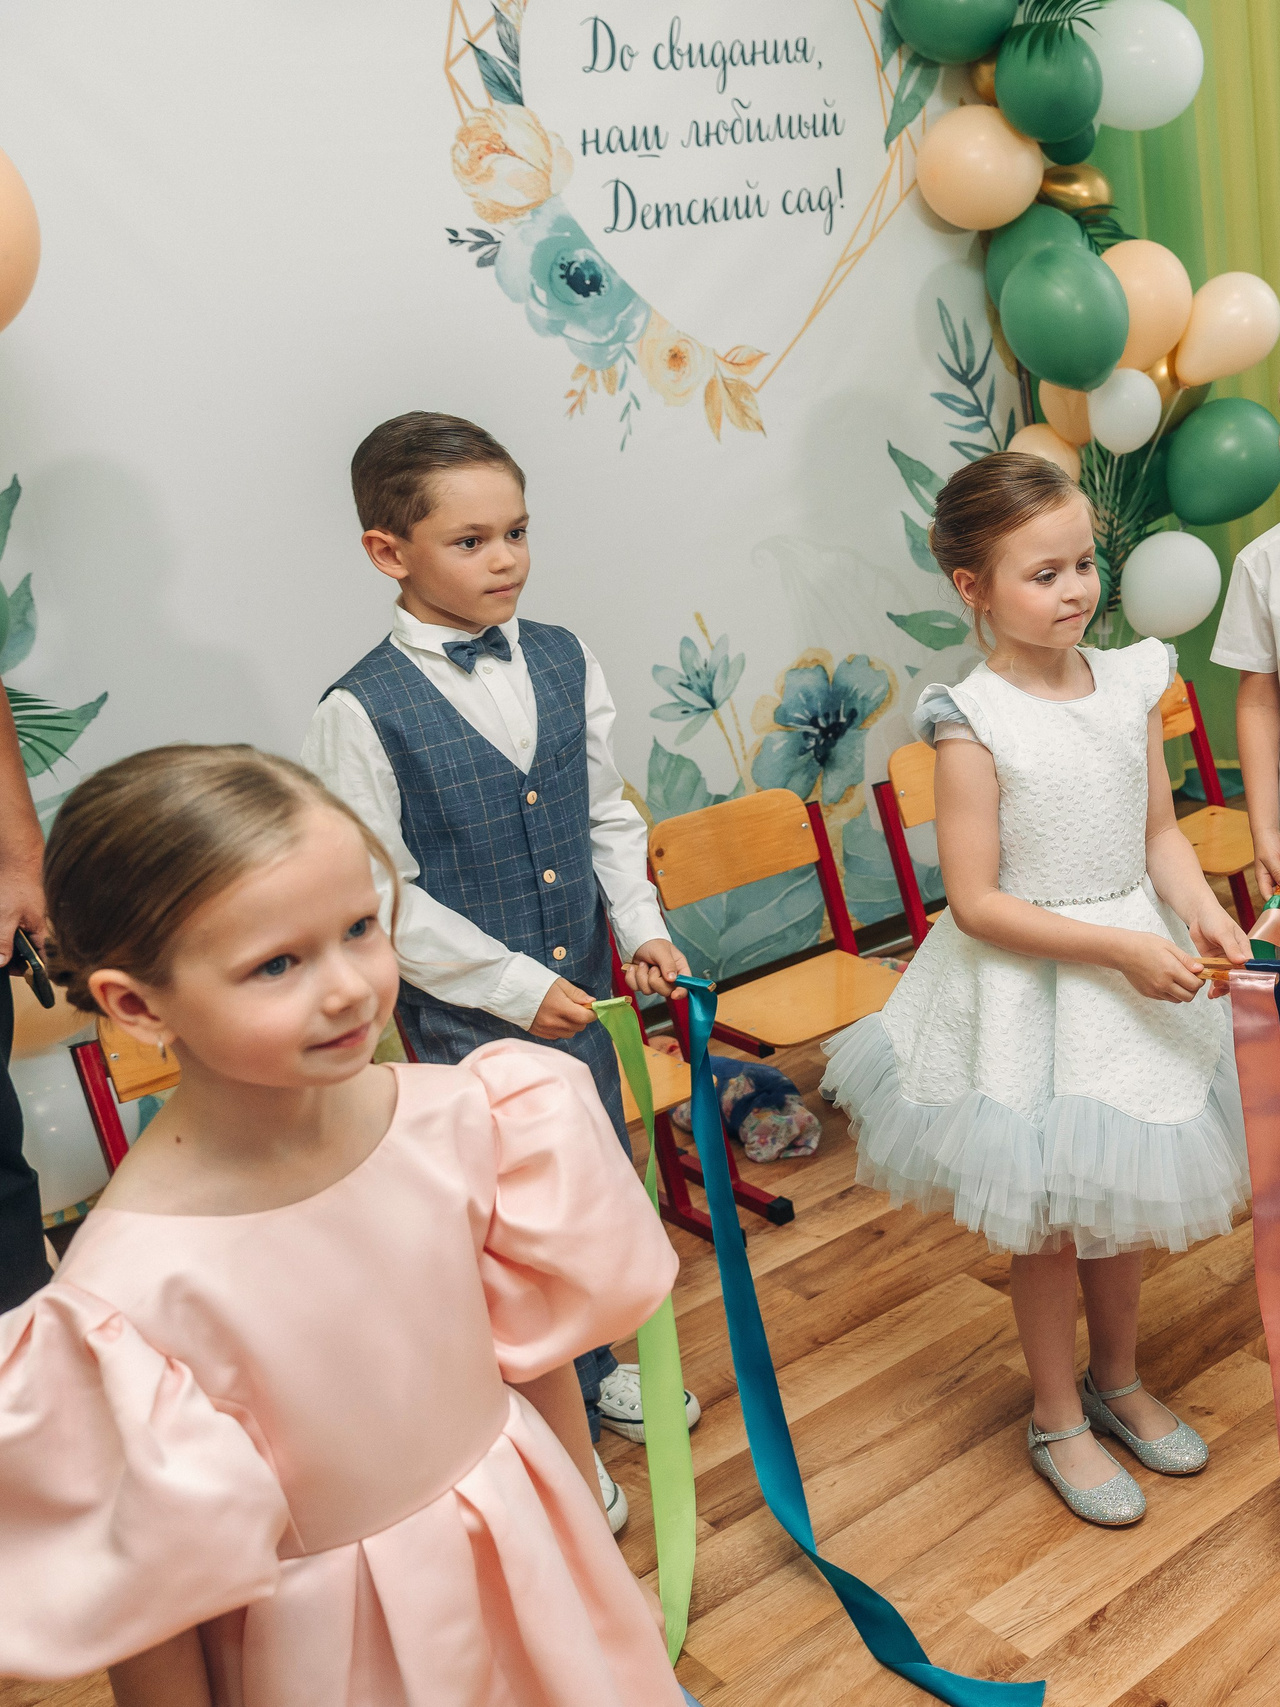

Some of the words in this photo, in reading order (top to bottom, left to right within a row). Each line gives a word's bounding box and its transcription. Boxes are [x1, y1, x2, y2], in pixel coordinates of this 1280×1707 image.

[579, 15, 639, 73] До
[653, 15, 822, 94] свидания,
[581, 123, 669, 158] наш
[681, 97, 845, 148] любимый
[602, 177, 769, 233] Детский
[782, 167, 845, 235] сад!
